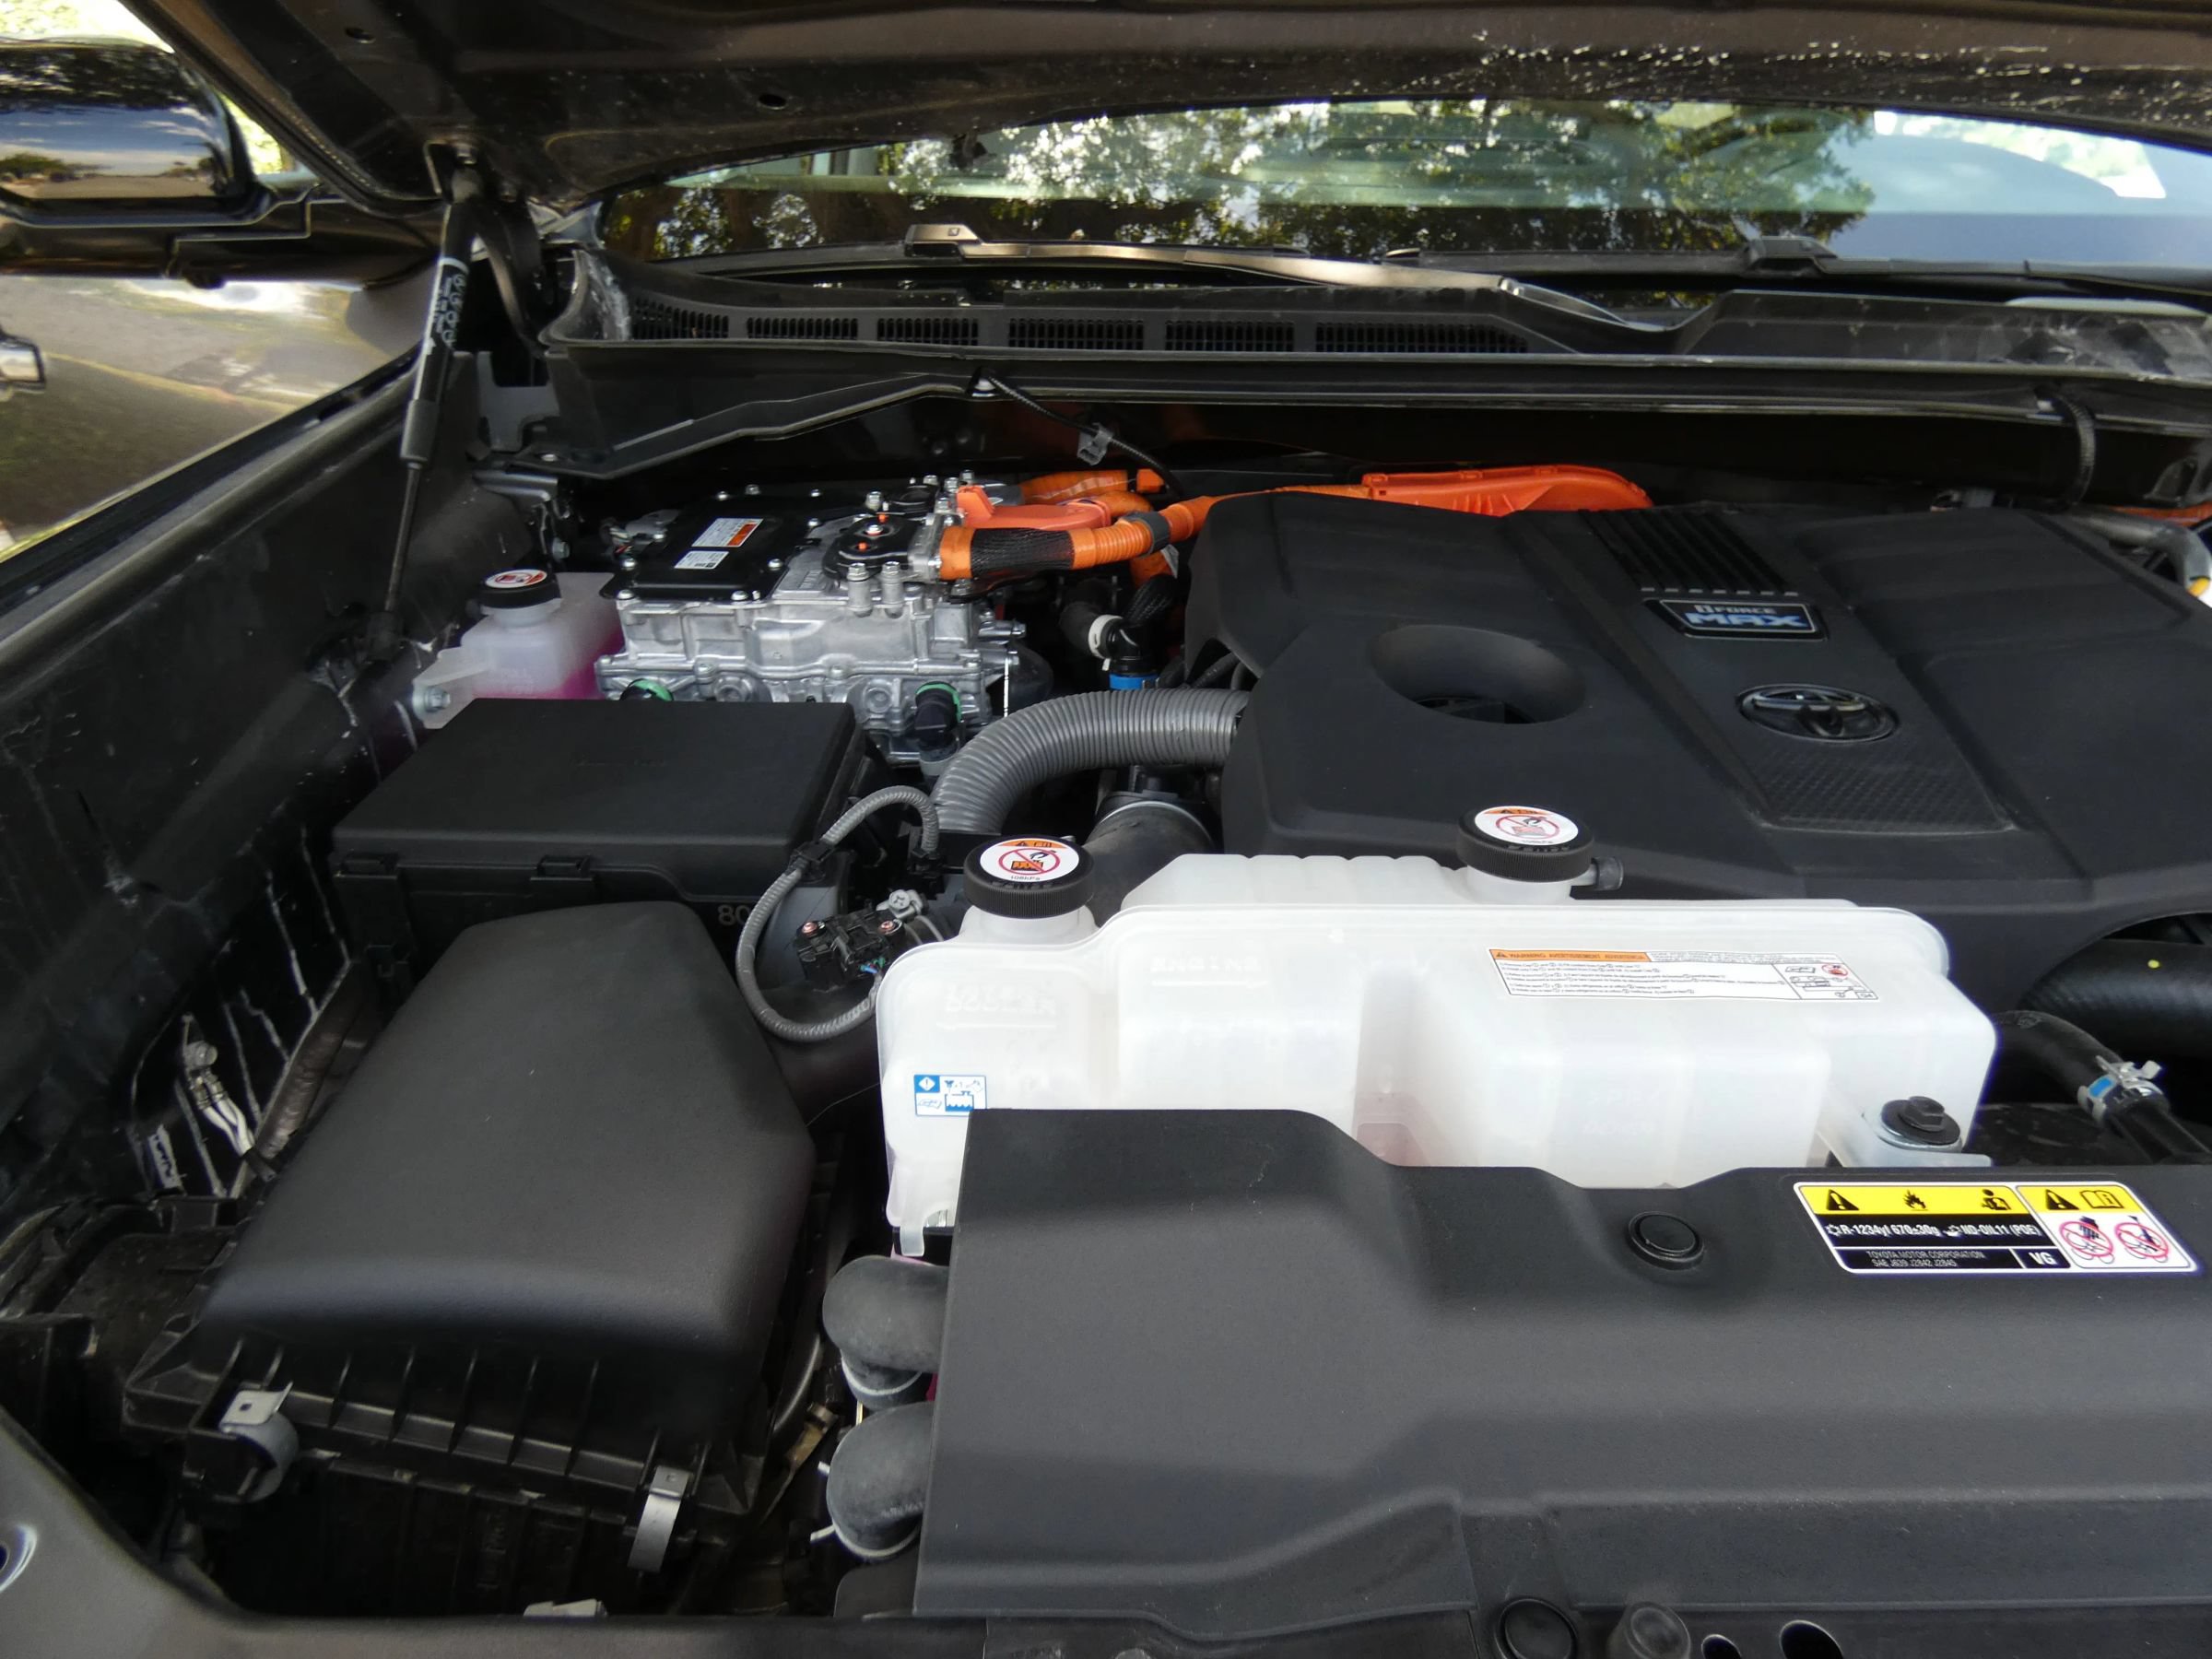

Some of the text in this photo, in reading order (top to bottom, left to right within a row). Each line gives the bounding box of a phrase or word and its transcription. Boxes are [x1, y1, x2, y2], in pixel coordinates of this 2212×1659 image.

[1685, 612, 1808, 628] MAX
[1865, 1250, 1986, 1259] TOYOTA MOTOR CORPORATION
[1871, 1258, 1889, 1267] SAE
